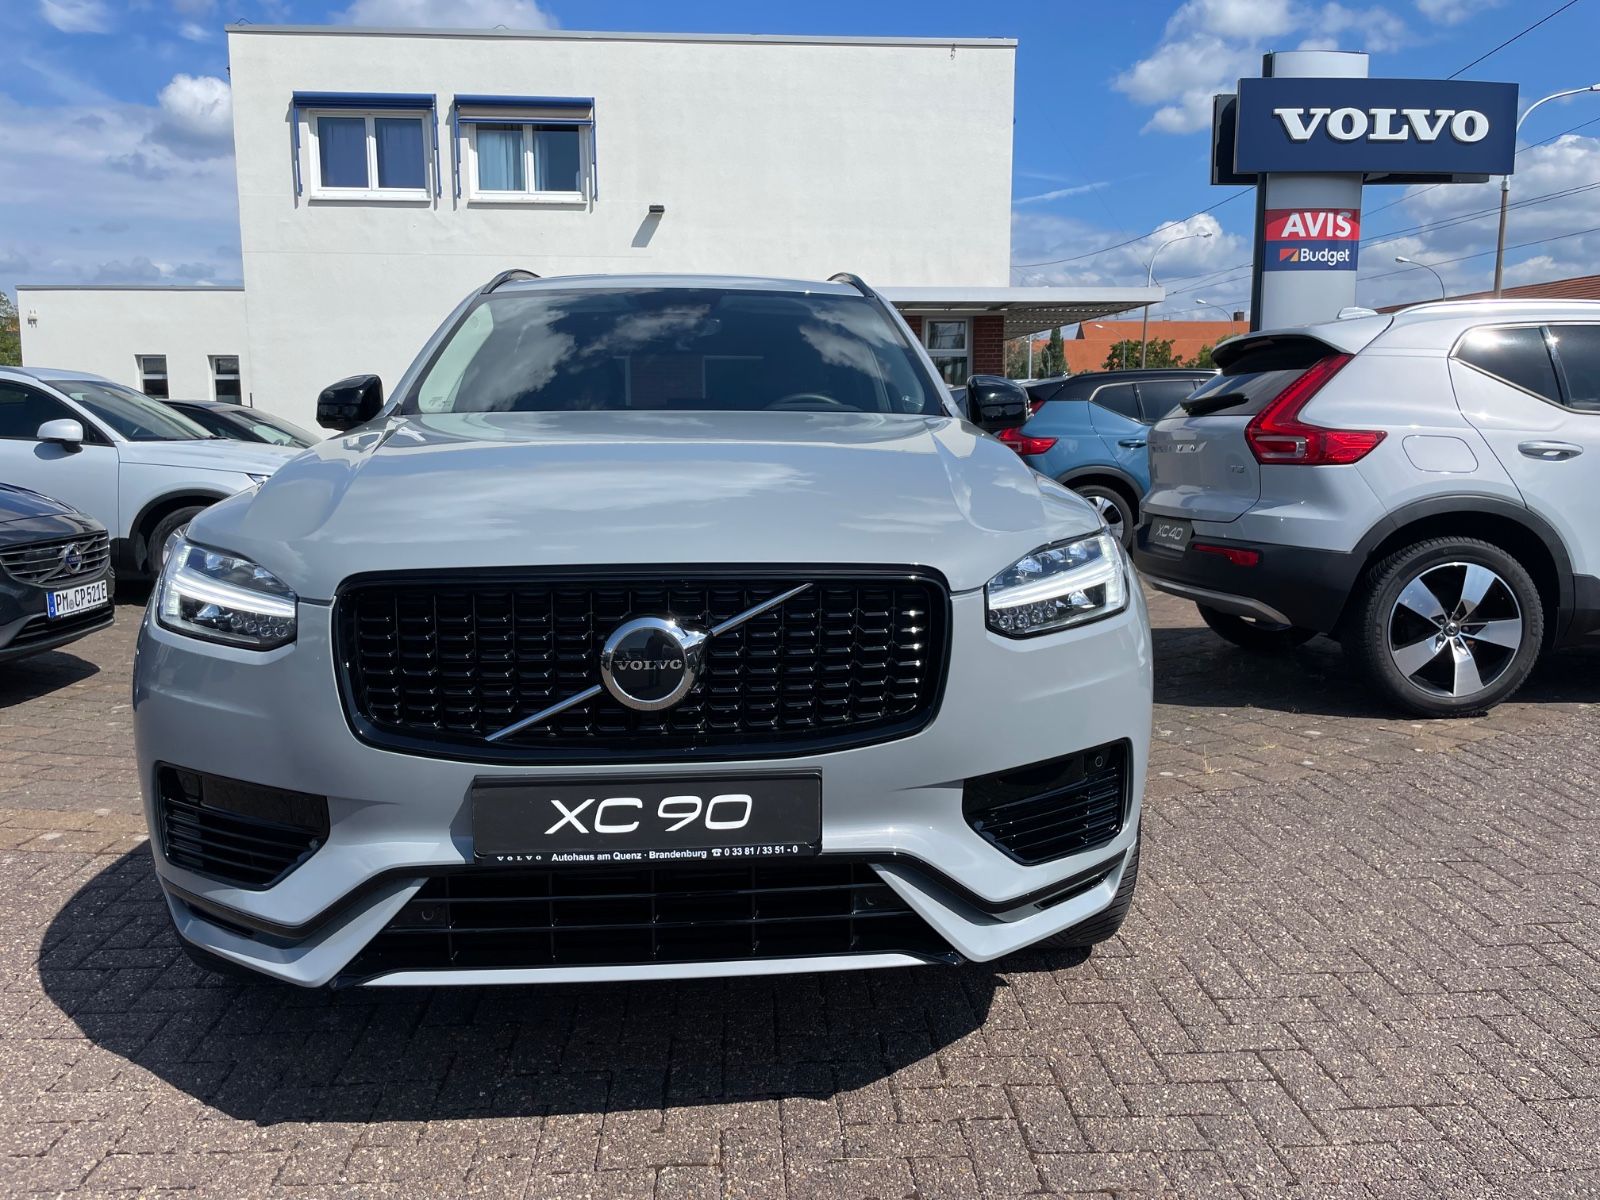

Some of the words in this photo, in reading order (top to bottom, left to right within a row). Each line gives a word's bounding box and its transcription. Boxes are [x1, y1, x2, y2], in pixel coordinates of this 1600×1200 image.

[1272, 107, 1489, 142] VOLVO
[1281, 212, 1351, 237] AVIS
[1300, 248, 1350, 266] Budget
[56, 593, 69, 612] PM
[614, 659, 683, 671] VOLVO
[544, 797, 643, 834] XC
[657, 794, 753, 832] 90
[551, 852, 595, 861] Autohaus
[613, 851, 642, 860] Quenz
[649, 849, 707, 859] Brandenburg
